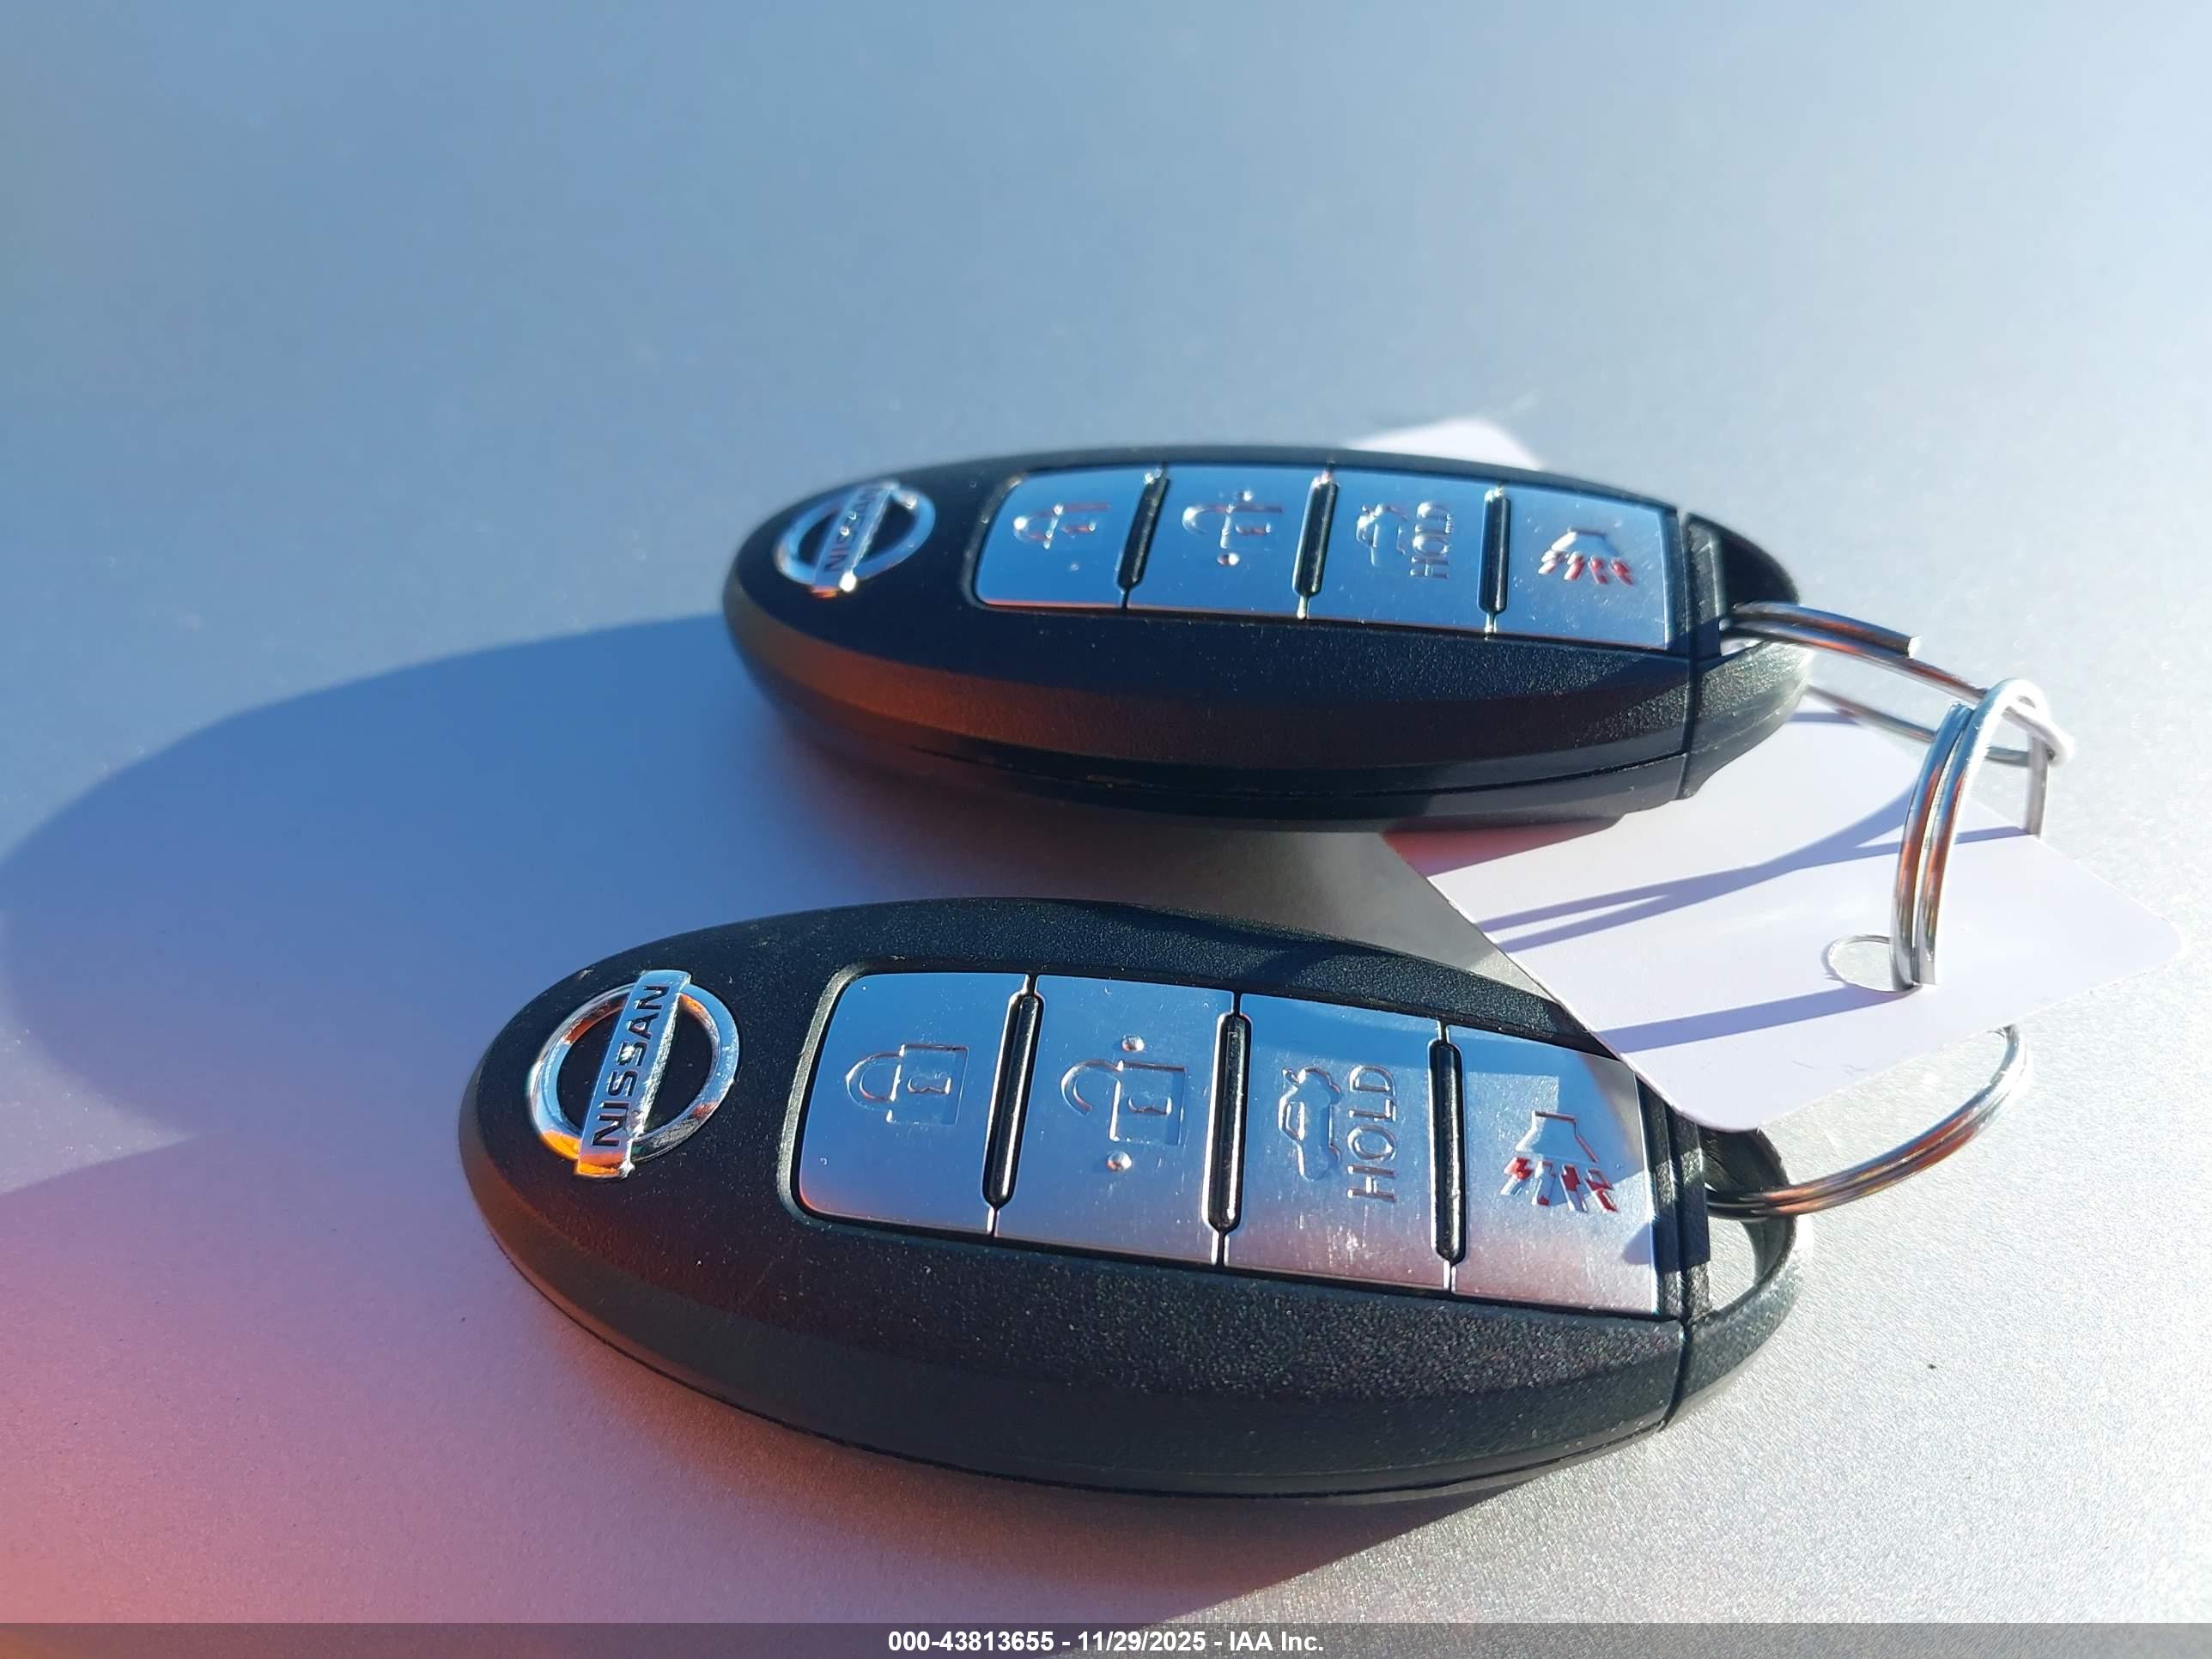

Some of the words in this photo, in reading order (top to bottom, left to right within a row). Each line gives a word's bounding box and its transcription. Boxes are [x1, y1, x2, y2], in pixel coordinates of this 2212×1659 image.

[1409, 501, 1452, 579] HOLD
[592, 985, 670, 1147] NISSAN
[1346, 1065, 1396, 1203] HOLD
